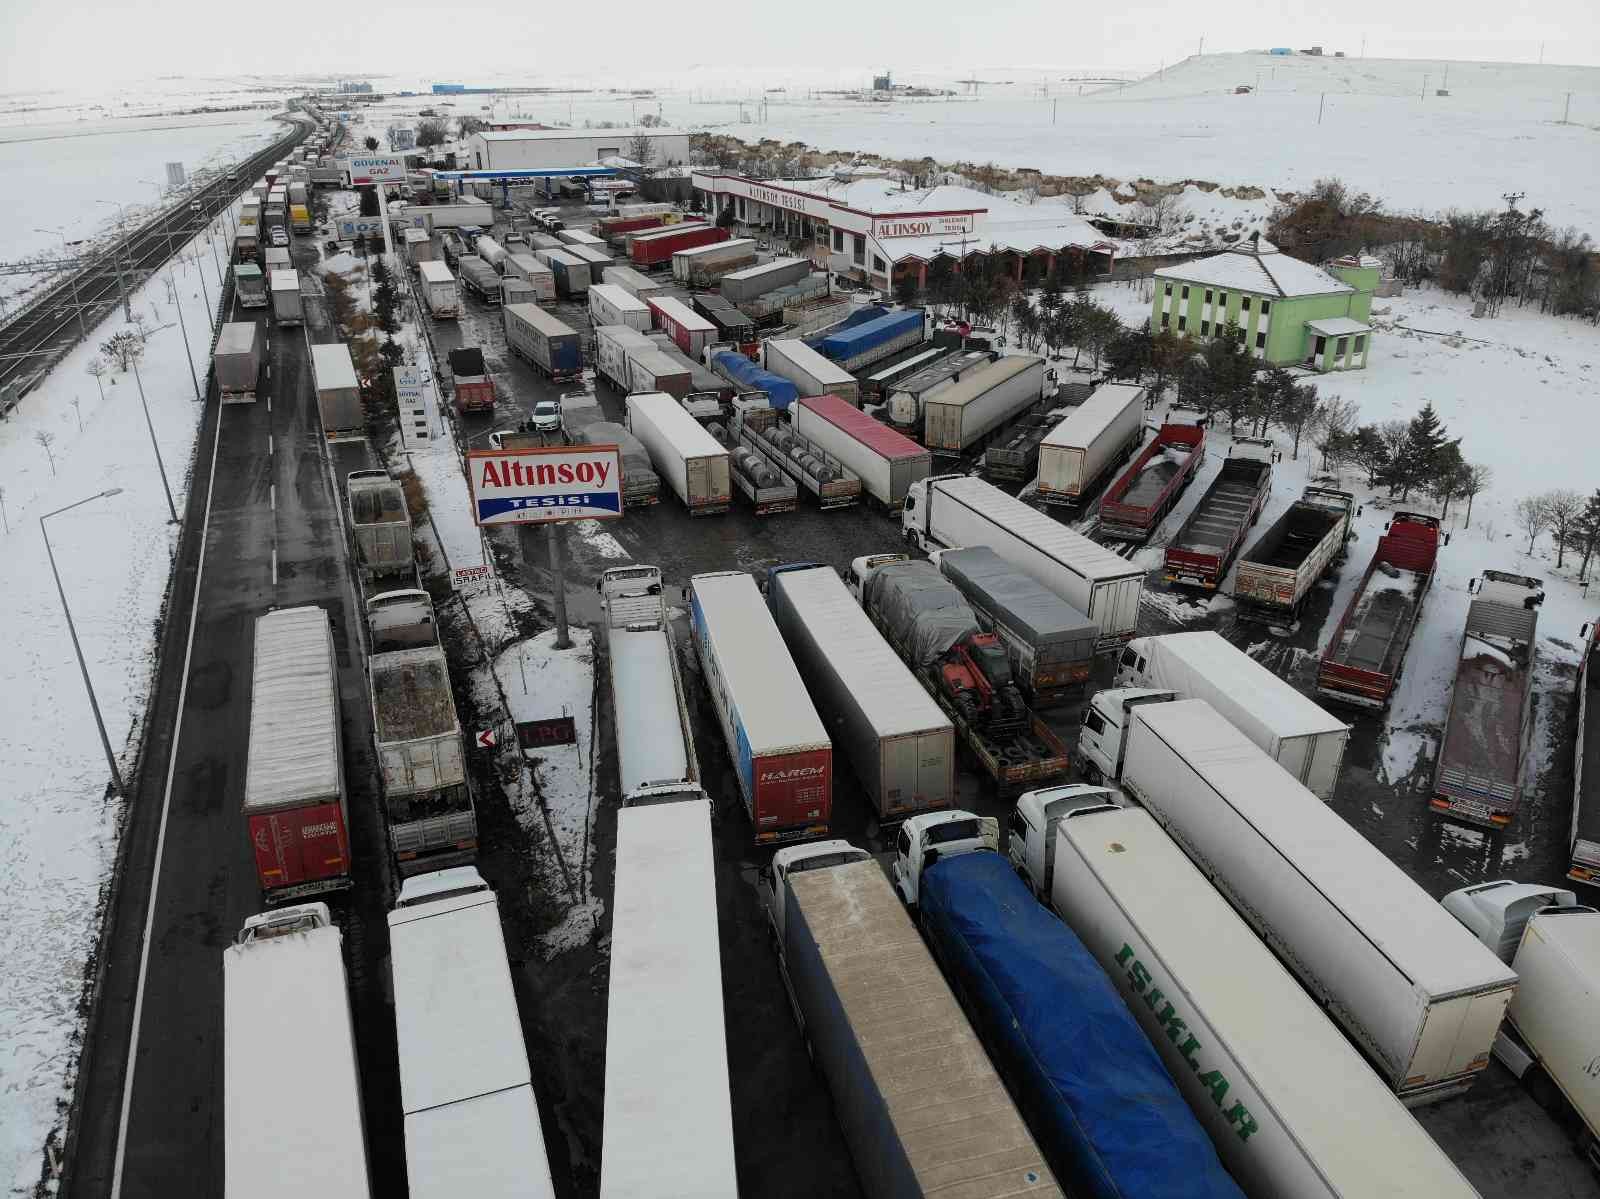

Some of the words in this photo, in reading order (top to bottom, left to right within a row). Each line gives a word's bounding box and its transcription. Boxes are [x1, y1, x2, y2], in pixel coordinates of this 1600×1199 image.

[878, 223, 933, 236] ALTINSOY
[481, 460, 611, 489] Altınsoy
[761, 766, 824, 781] HAREM
[1114, 942, 1258, 1143] IŞIKLAR
